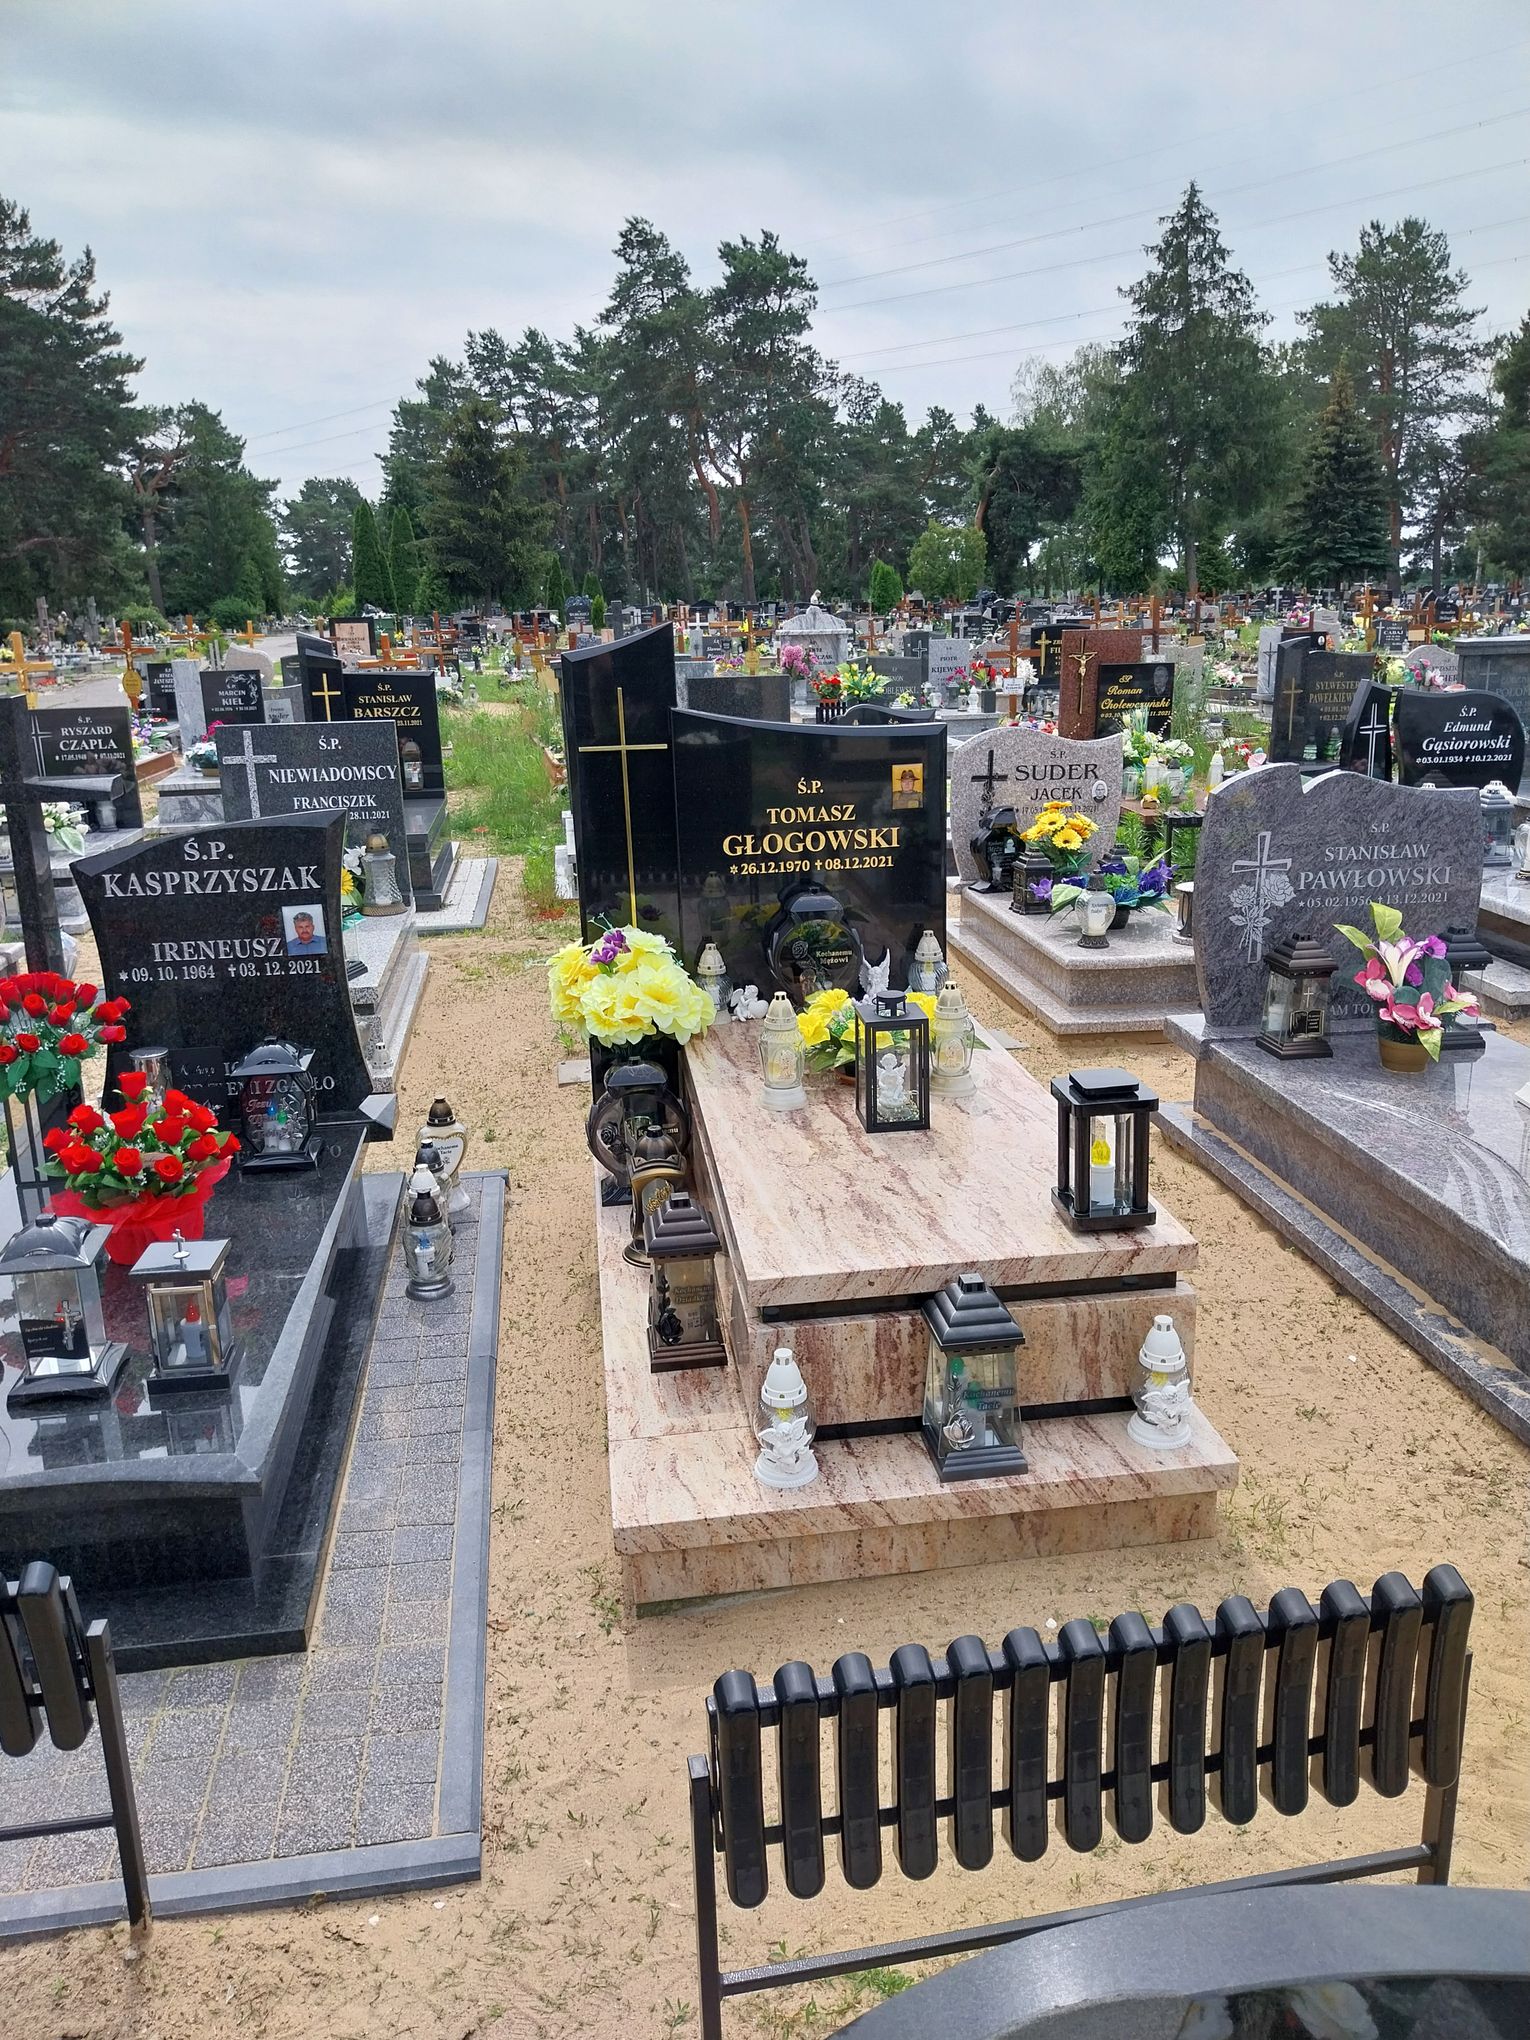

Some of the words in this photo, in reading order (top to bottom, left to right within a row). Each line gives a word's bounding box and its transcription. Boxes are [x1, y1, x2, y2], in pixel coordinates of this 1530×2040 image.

[377, 683, 392, 691] Ś.P.
[1107, 685, 1144, 696] Roman
[222, 698, 245, 706] KIEL
[358, 694, 413, 704] STANISŁAW
[353, 706, 421, 718] BARSZCZ
[1459, 704, 1477, 717] Ś.P.
[60, 725, 113, 736] RYSZARD
[1443, 720, 1493, 733] Edmund
[59, 738, 118, 751] CZAPLA
[318, 735, 342, 750] Ś.P.
[1422, 734, 1512, 754] Gąsiorowski
[1470, 754, 1513, 763] 10.12.2021
[268, 764, 398, 784] NIEWIADOMSCY
[1015, 763, 1099, 782] SUDER
[797, 776, 824, 795] Ś.P.
[1030, 786, 1082, 801] JACEK
[293, 794, 378, 810] FRANCISZEK
[349, 810, 390, 821] 28.11.2021
[767, 804, 856, 825] TOMASZ
[722, 826, 900, 857] GŁOGOWSKI
[183, 837, 234, 862] Ś.P.
[1324, 843, 1431, 862] STANISŁAW
[740, 858, 811, 875] 26.12.1970
[824, 855, 895, 871] 08.12.2021
[101, 865, 321, 898] KASPRZYSZAK
[1298, 866, 1453, 890] PAWŁOWSKI
[1386, 892, 1448, 905] 13.12.2021
[151, 937, 284, 962] IRENEUSZ
